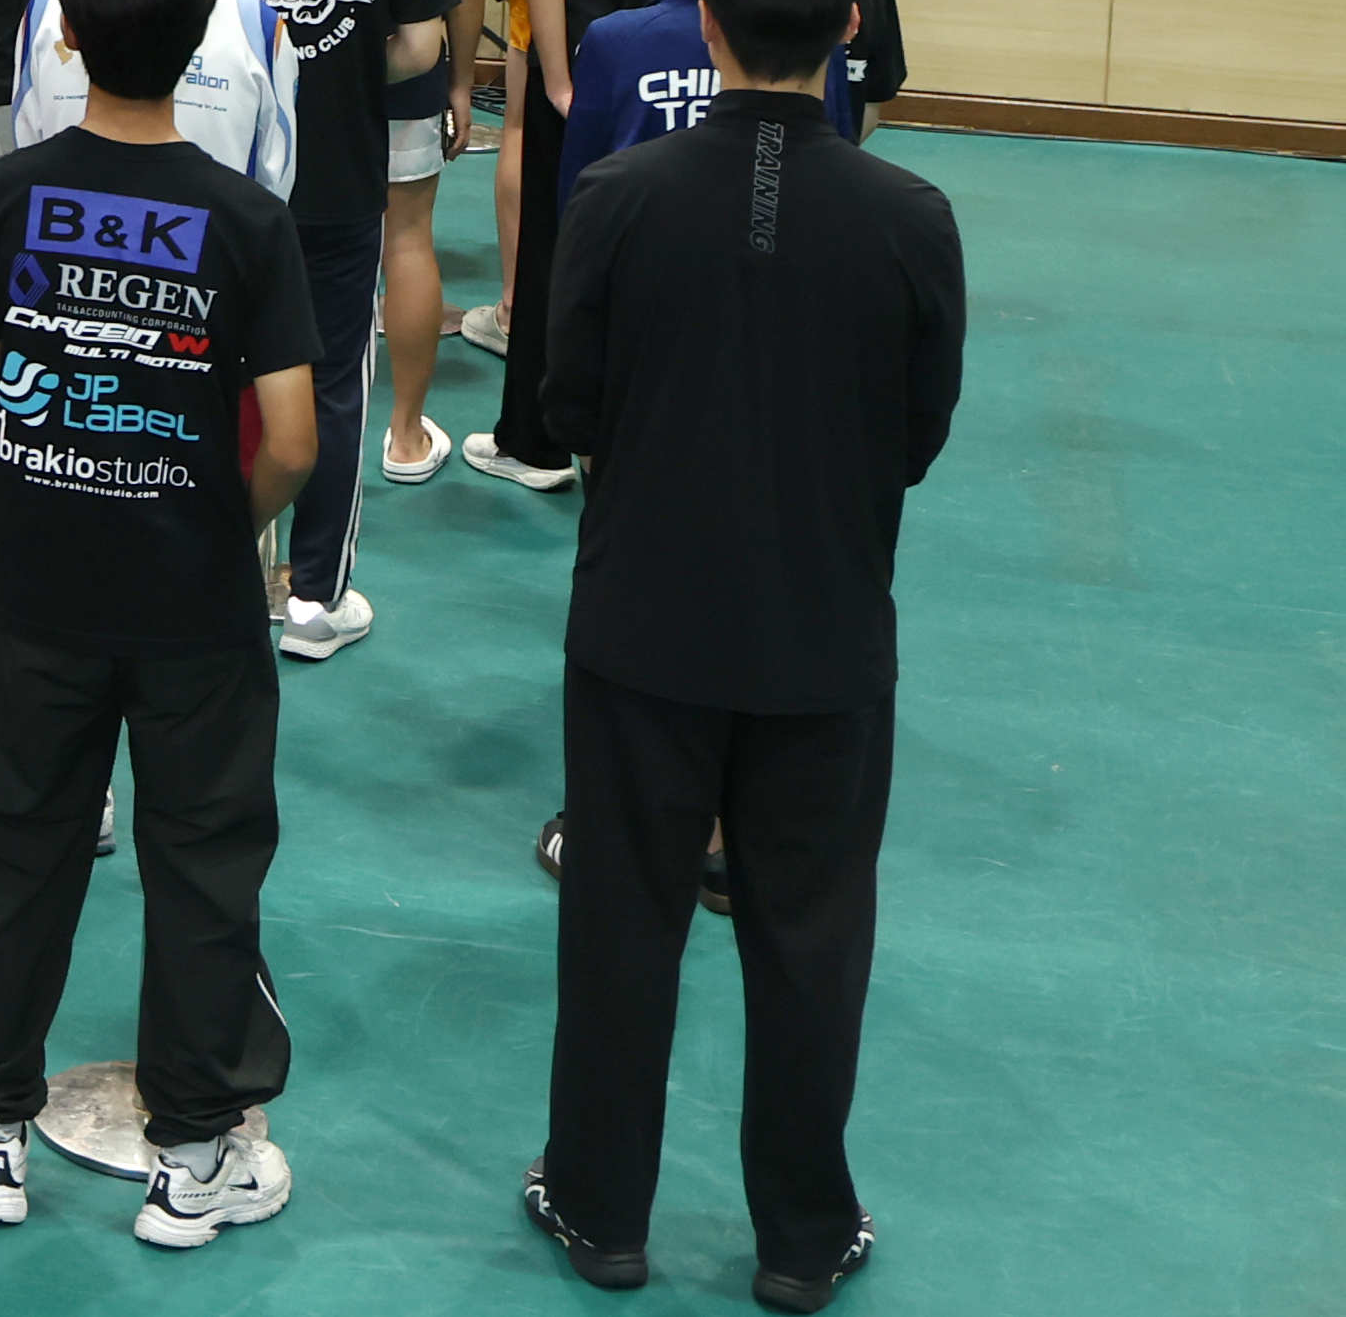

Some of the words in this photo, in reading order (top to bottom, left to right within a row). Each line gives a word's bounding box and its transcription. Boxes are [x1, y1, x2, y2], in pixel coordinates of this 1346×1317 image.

[318, 16, 356, 53] CLUB
[749, 120, 785, 255] TRAINING
[55, 262, 219, 321] REGEN
[141, 316, 207, 336] CORPORATION
[66, 372, 120, 402] JP
[24, 473, 160, 499] www.brakiostudio.com
